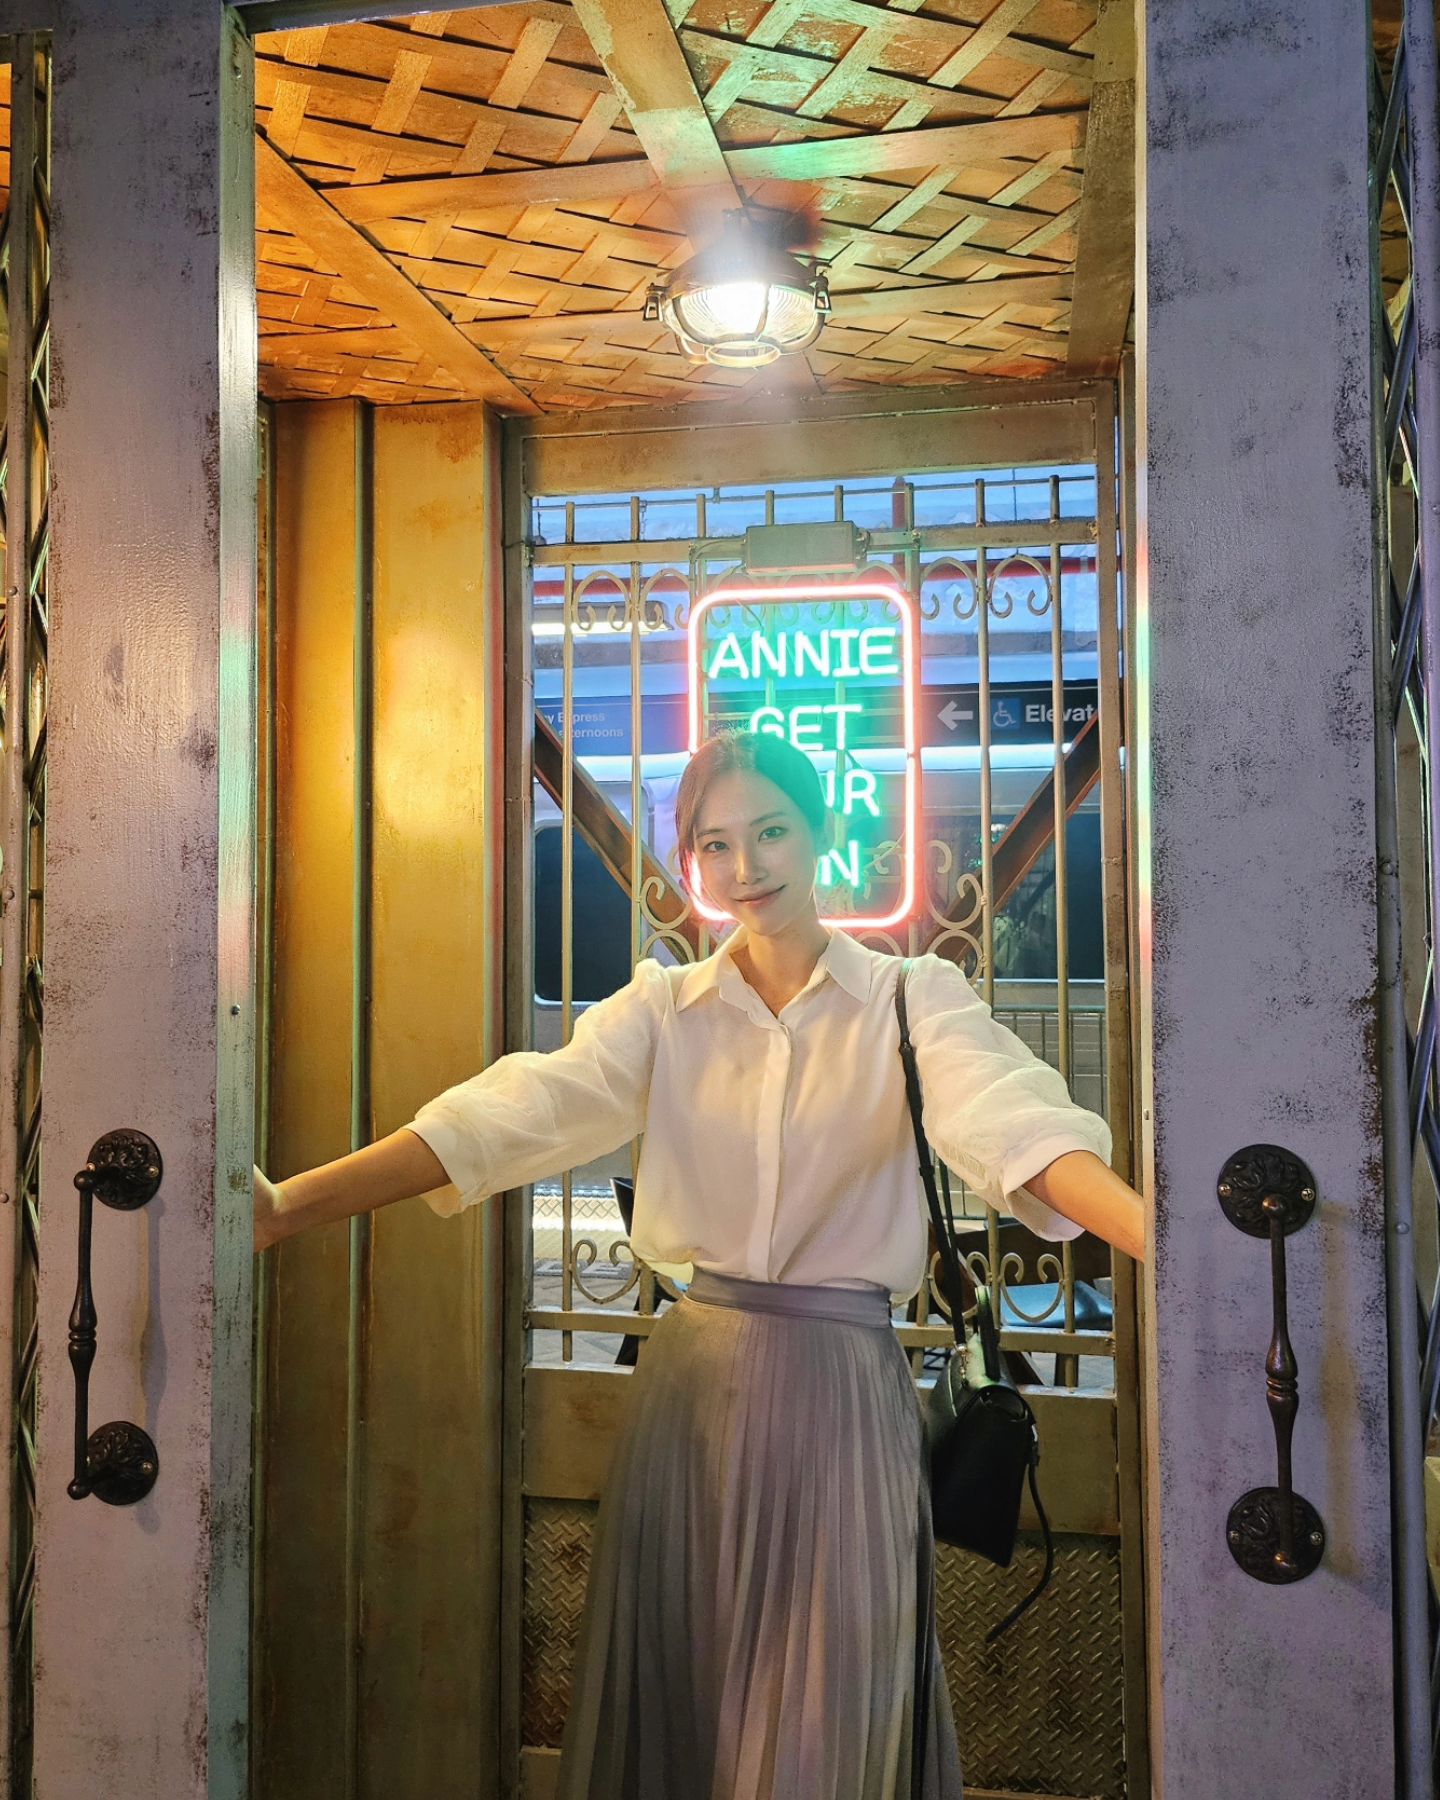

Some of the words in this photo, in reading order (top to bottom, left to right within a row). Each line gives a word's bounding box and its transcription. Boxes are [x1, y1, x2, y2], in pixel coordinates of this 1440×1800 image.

[709, 627, 899, 679] ANNIE
[557, 711, 605, 724] Epress
[751, 704, 862, 751] GET
